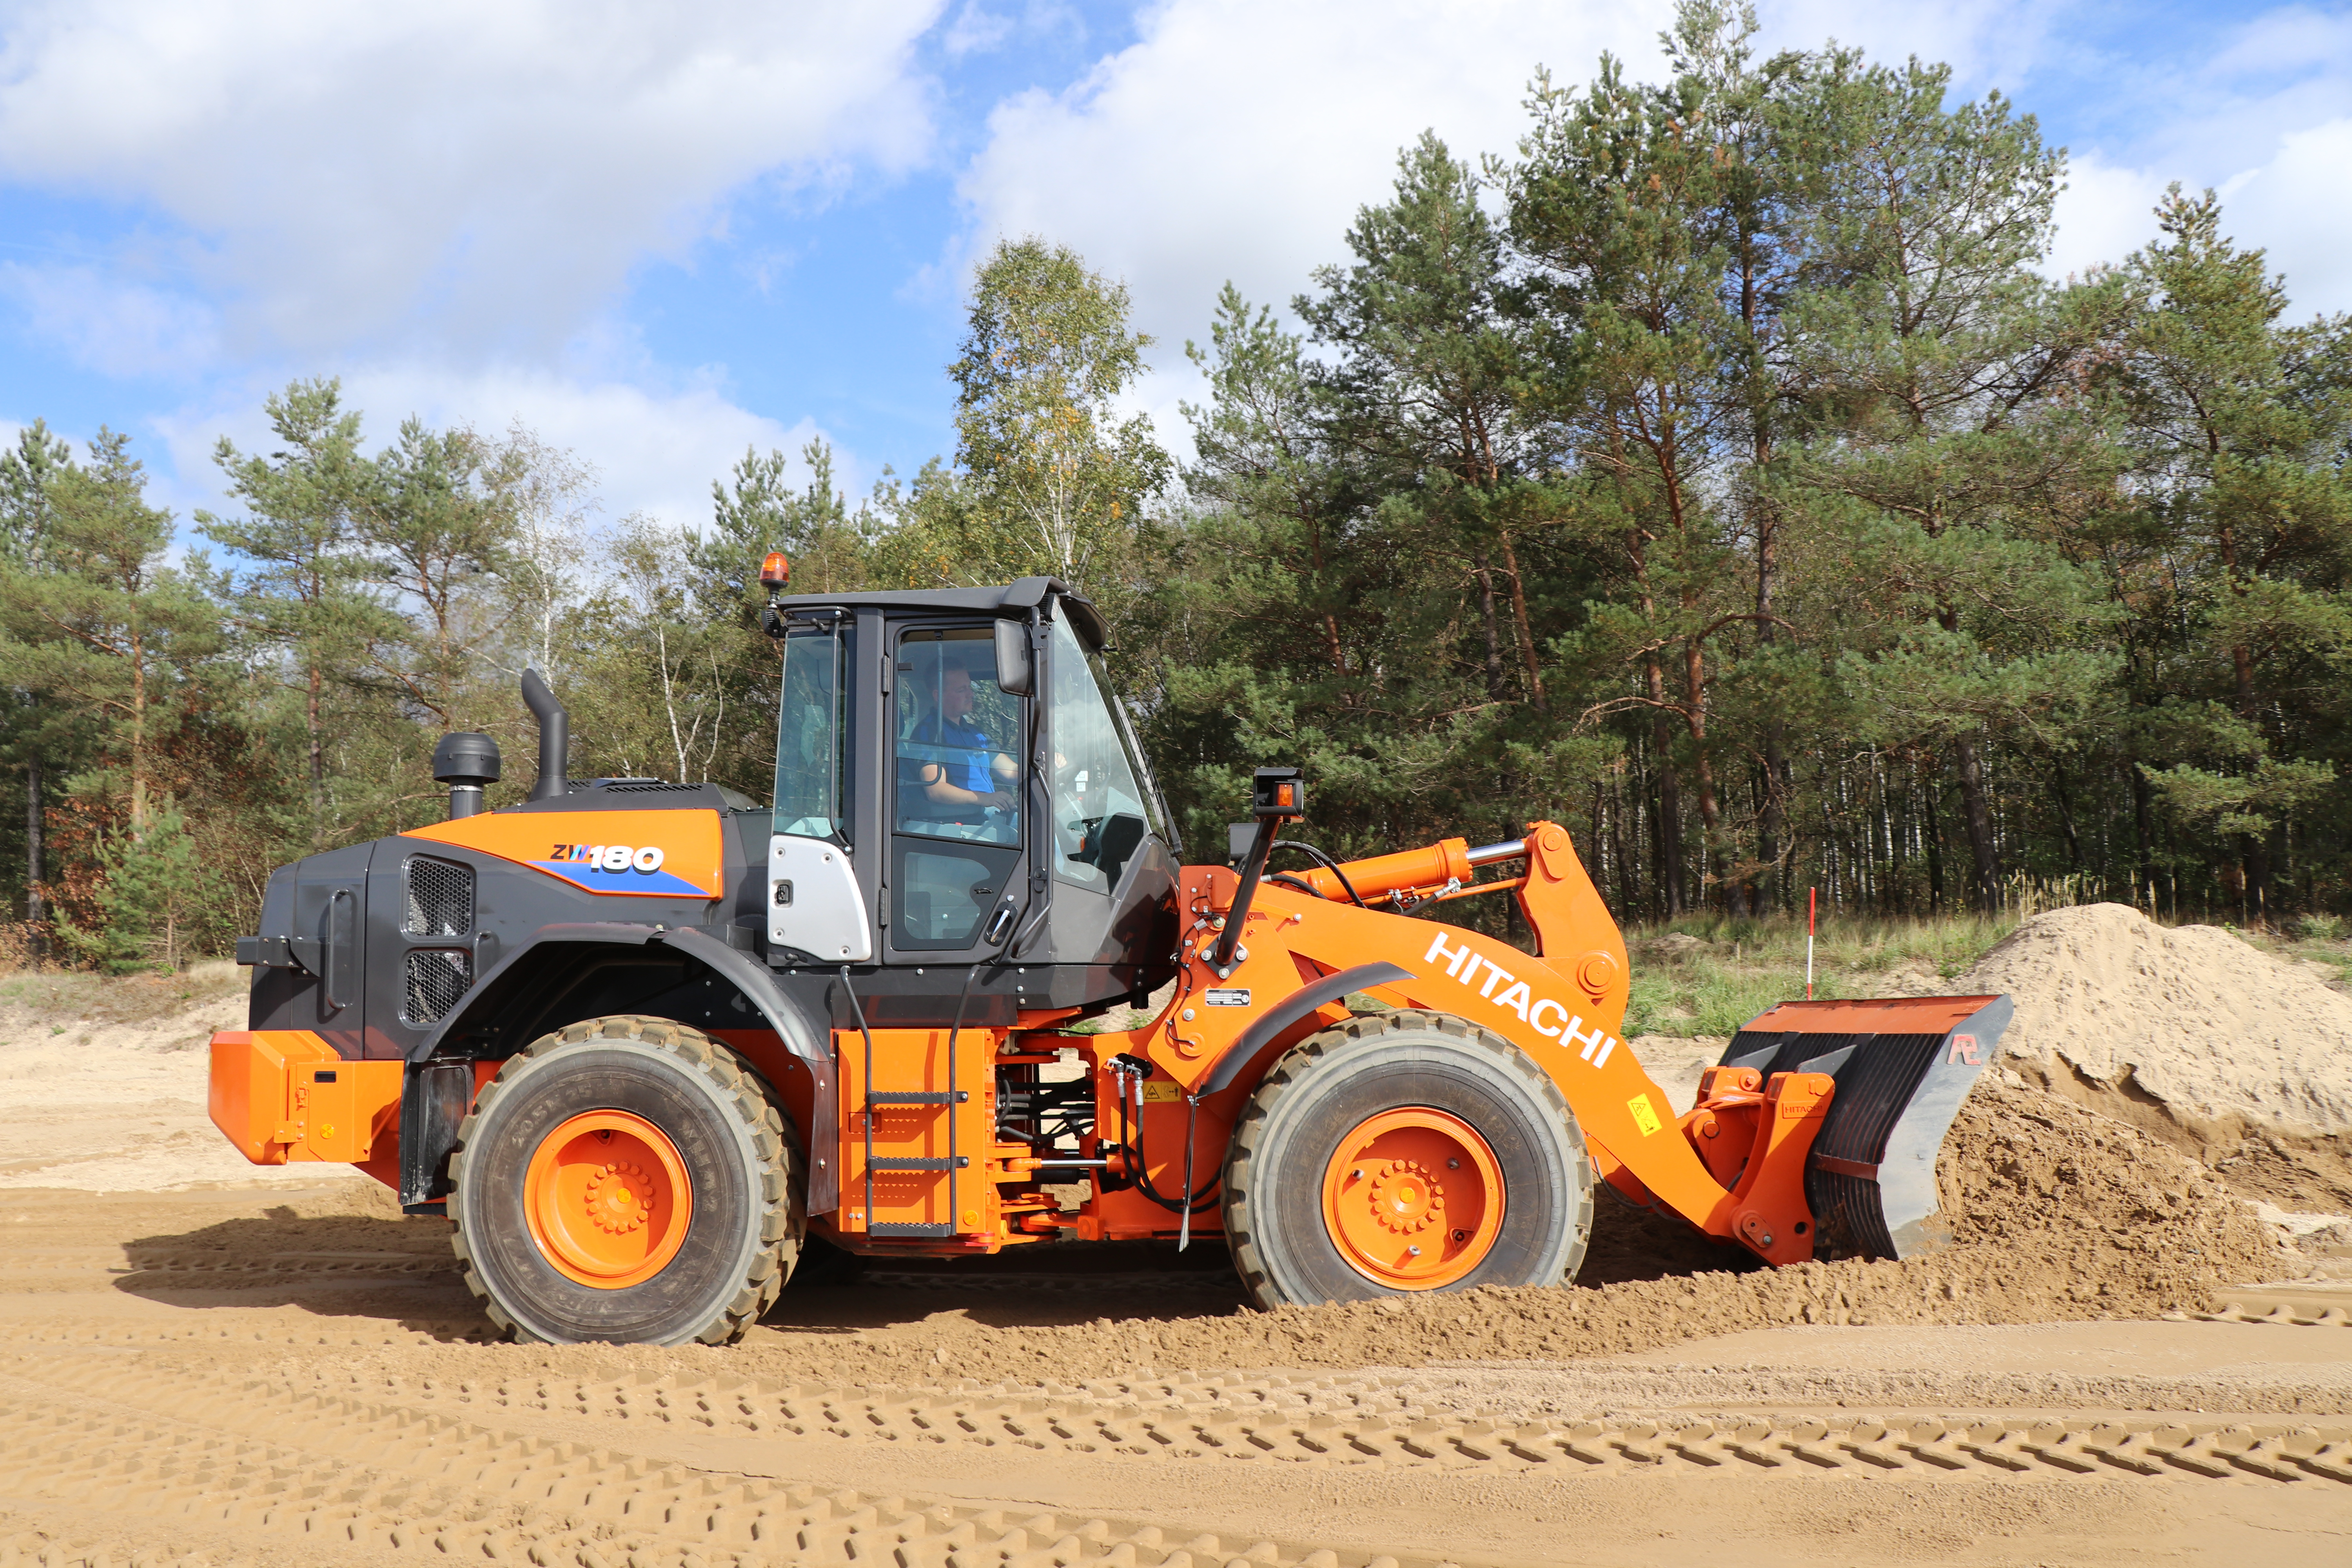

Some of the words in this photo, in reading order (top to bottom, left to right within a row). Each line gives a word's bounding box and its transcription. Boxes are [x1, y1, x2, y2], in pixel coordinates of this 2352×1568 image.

[589, 845, 663, 875] 180
[1424, 931, 1617, 1069] HITACHI
[1785, 1105, 1823, 1114] HITACHI
